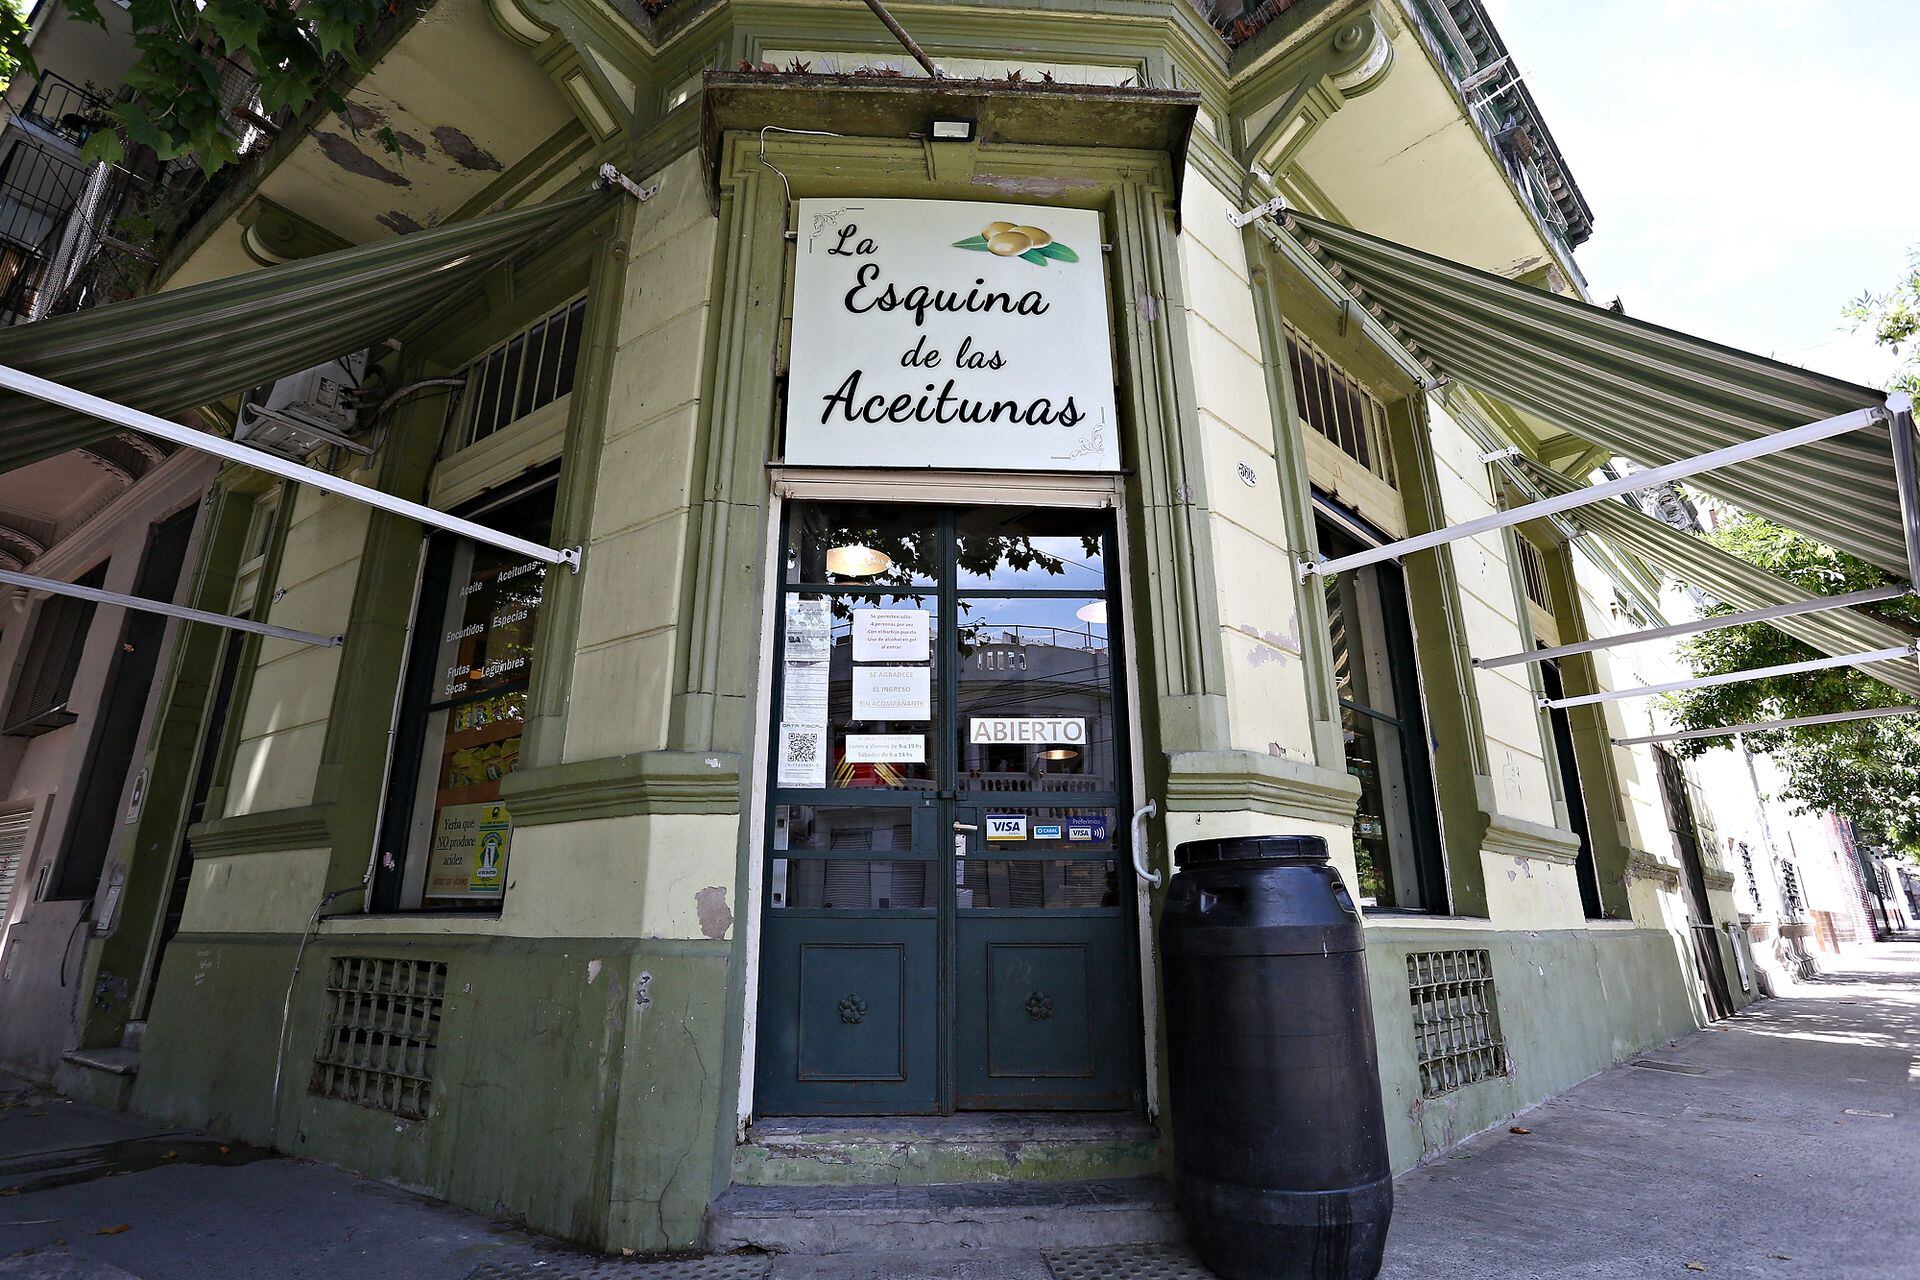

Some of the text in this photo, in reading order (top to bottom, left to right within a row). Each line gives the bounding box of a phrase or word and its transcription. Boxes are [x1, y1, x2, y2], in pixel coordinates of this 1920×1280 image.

[827, 224, 878, 257] La
[844, 263, 1050, 326] Esquina
[900, 335, 1007, 370] de las
[820, 369, 1086, 427] Aceitunas
[497, 561, 538, 583] Aceitunas
[459, 580, 483, 597] Aceite
[492, 609, 528, 629] Especias
[446, 622, 485, 643] Encurtidos
[447, 664, 470, 679] Frutas
[480, 656, 525, 679] Legumbres
[445, 681, 467, 695] Secas
[974, 720, 1083, 742] ABIERTO
[444, 818, 475, 831] Yerba que
[992, 821, 1021, 832] VISA
[437, 836, 449, 848] NO
[449, 836, 475, 850] produce
[443, 854, 463, 866] acidez
